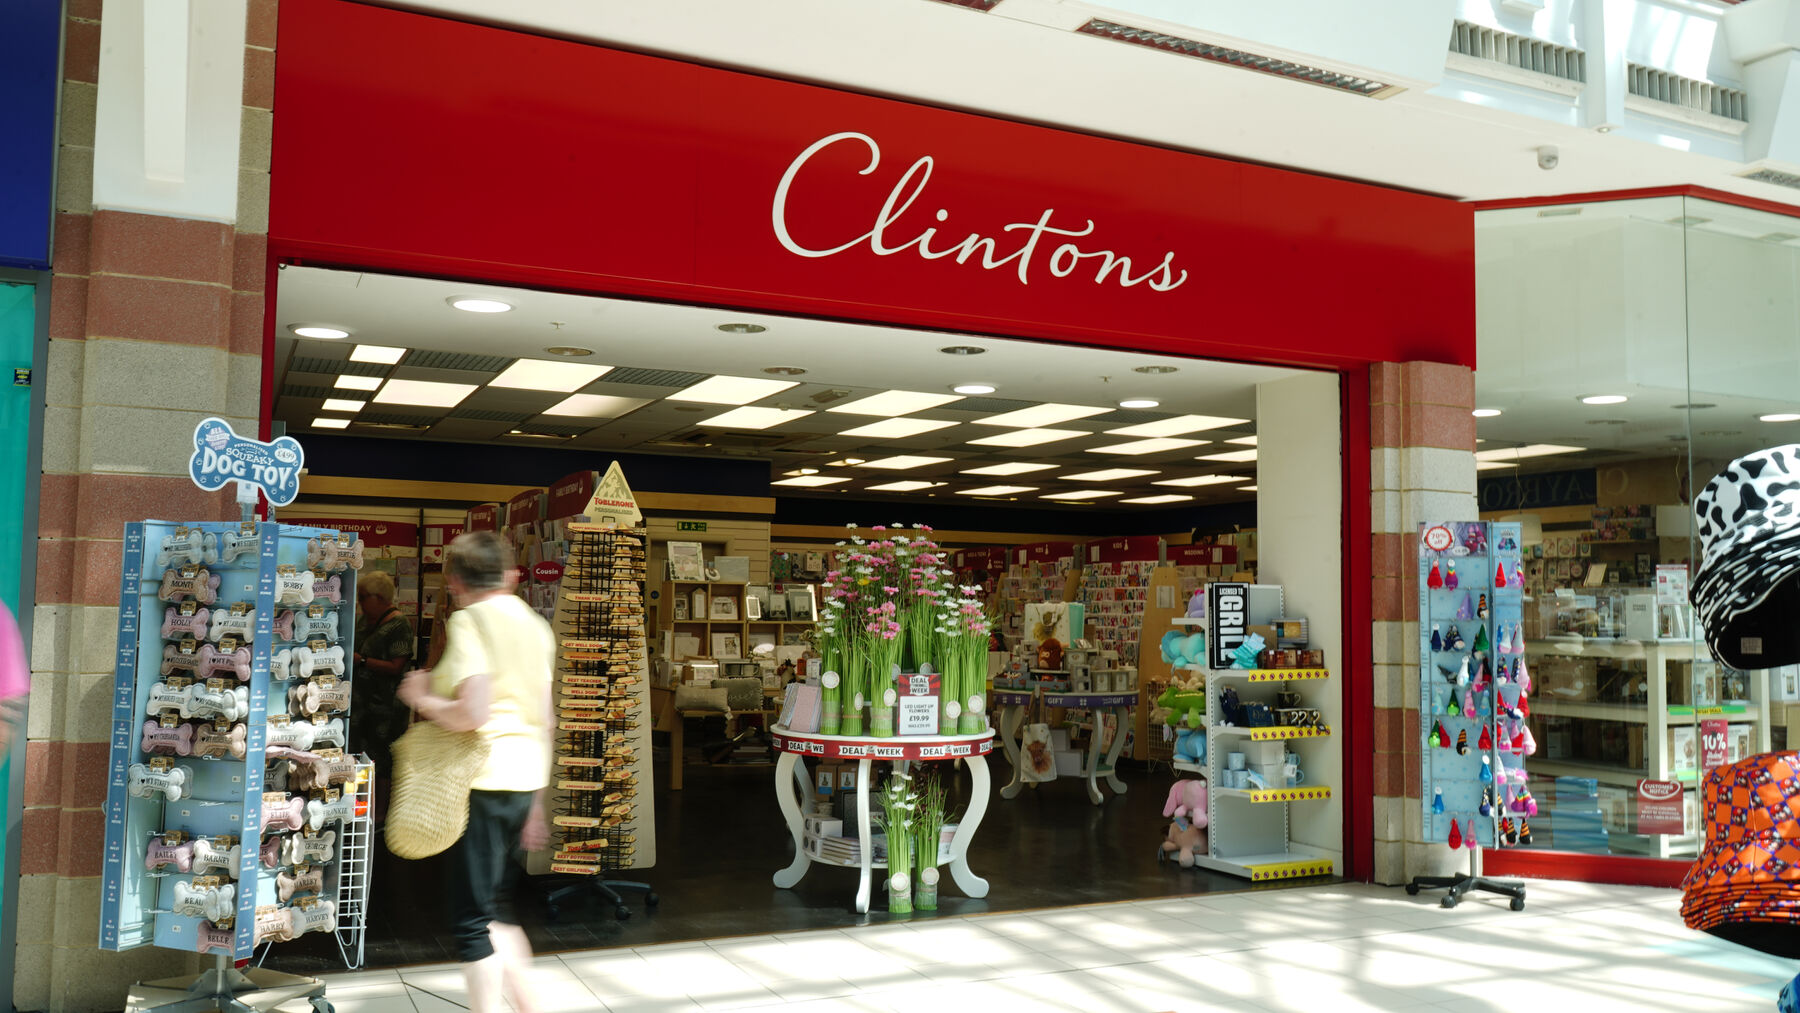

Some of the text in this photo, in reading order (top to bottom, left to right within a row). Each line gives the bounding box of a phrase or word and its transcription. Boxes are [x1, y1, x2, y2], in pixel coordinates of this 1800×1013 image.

[772, 131, 1188, 292] Clintons
[226, 447, 274, 466] SQUEAKY
[201, 446, 293, 491] DOG TOY
[594, 496, 634, 508] TOBLERONE
[332, 524, 372, 532] BIRTHDAY
[1220, 596, 1244, 661] GRILL
[1702, 732, 1726, 750] 10%
[789, 742, 804, 751] DEAL
[567, 844, 601, 852] TOBLONE
[204, 855, 230, 865] BARNEY
[184, 897, 204, 906] BEAU
[306, 913, 329, 923] HARVEY
[260, 922, 285, 932] HARRY
[207, 934, 230, 945] BELLE
